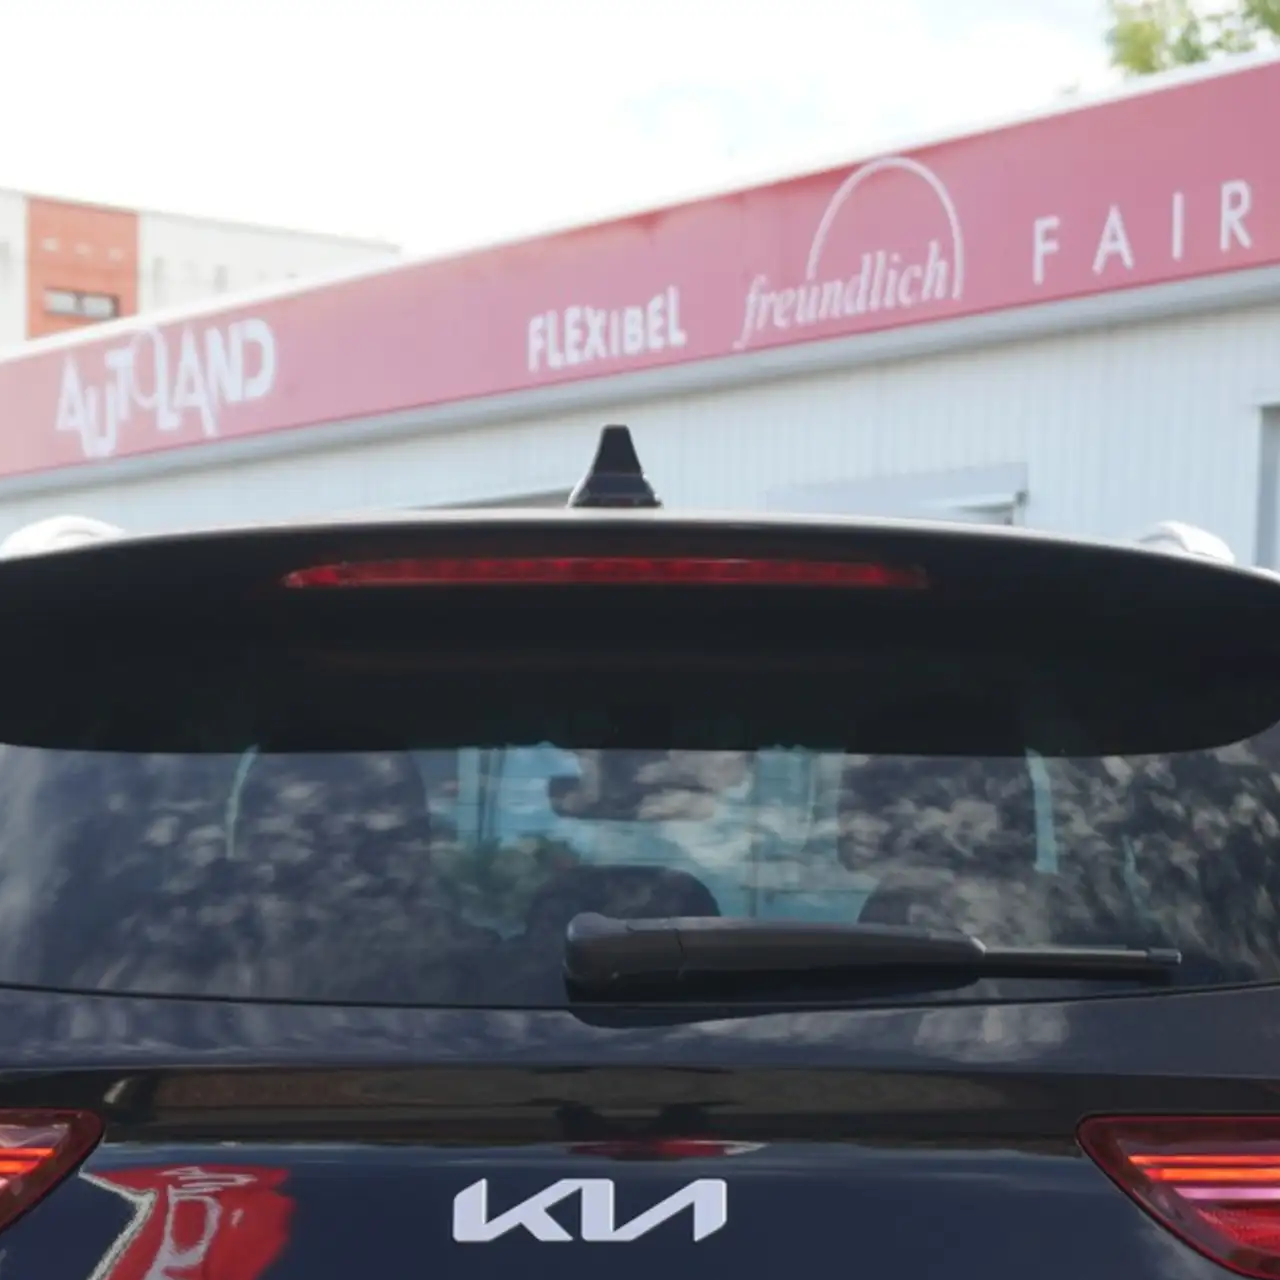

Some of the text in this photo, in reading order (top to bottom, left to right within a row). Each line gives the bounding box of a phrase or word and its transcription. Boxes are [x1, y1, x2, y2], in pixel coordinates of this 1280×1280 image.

[527, 178, 1254, 373] FLEXIBEL freundlich FAIR
[54, 317, 279, 459] AUTOLAND
[452, 1177, 728, 1242] KIA
